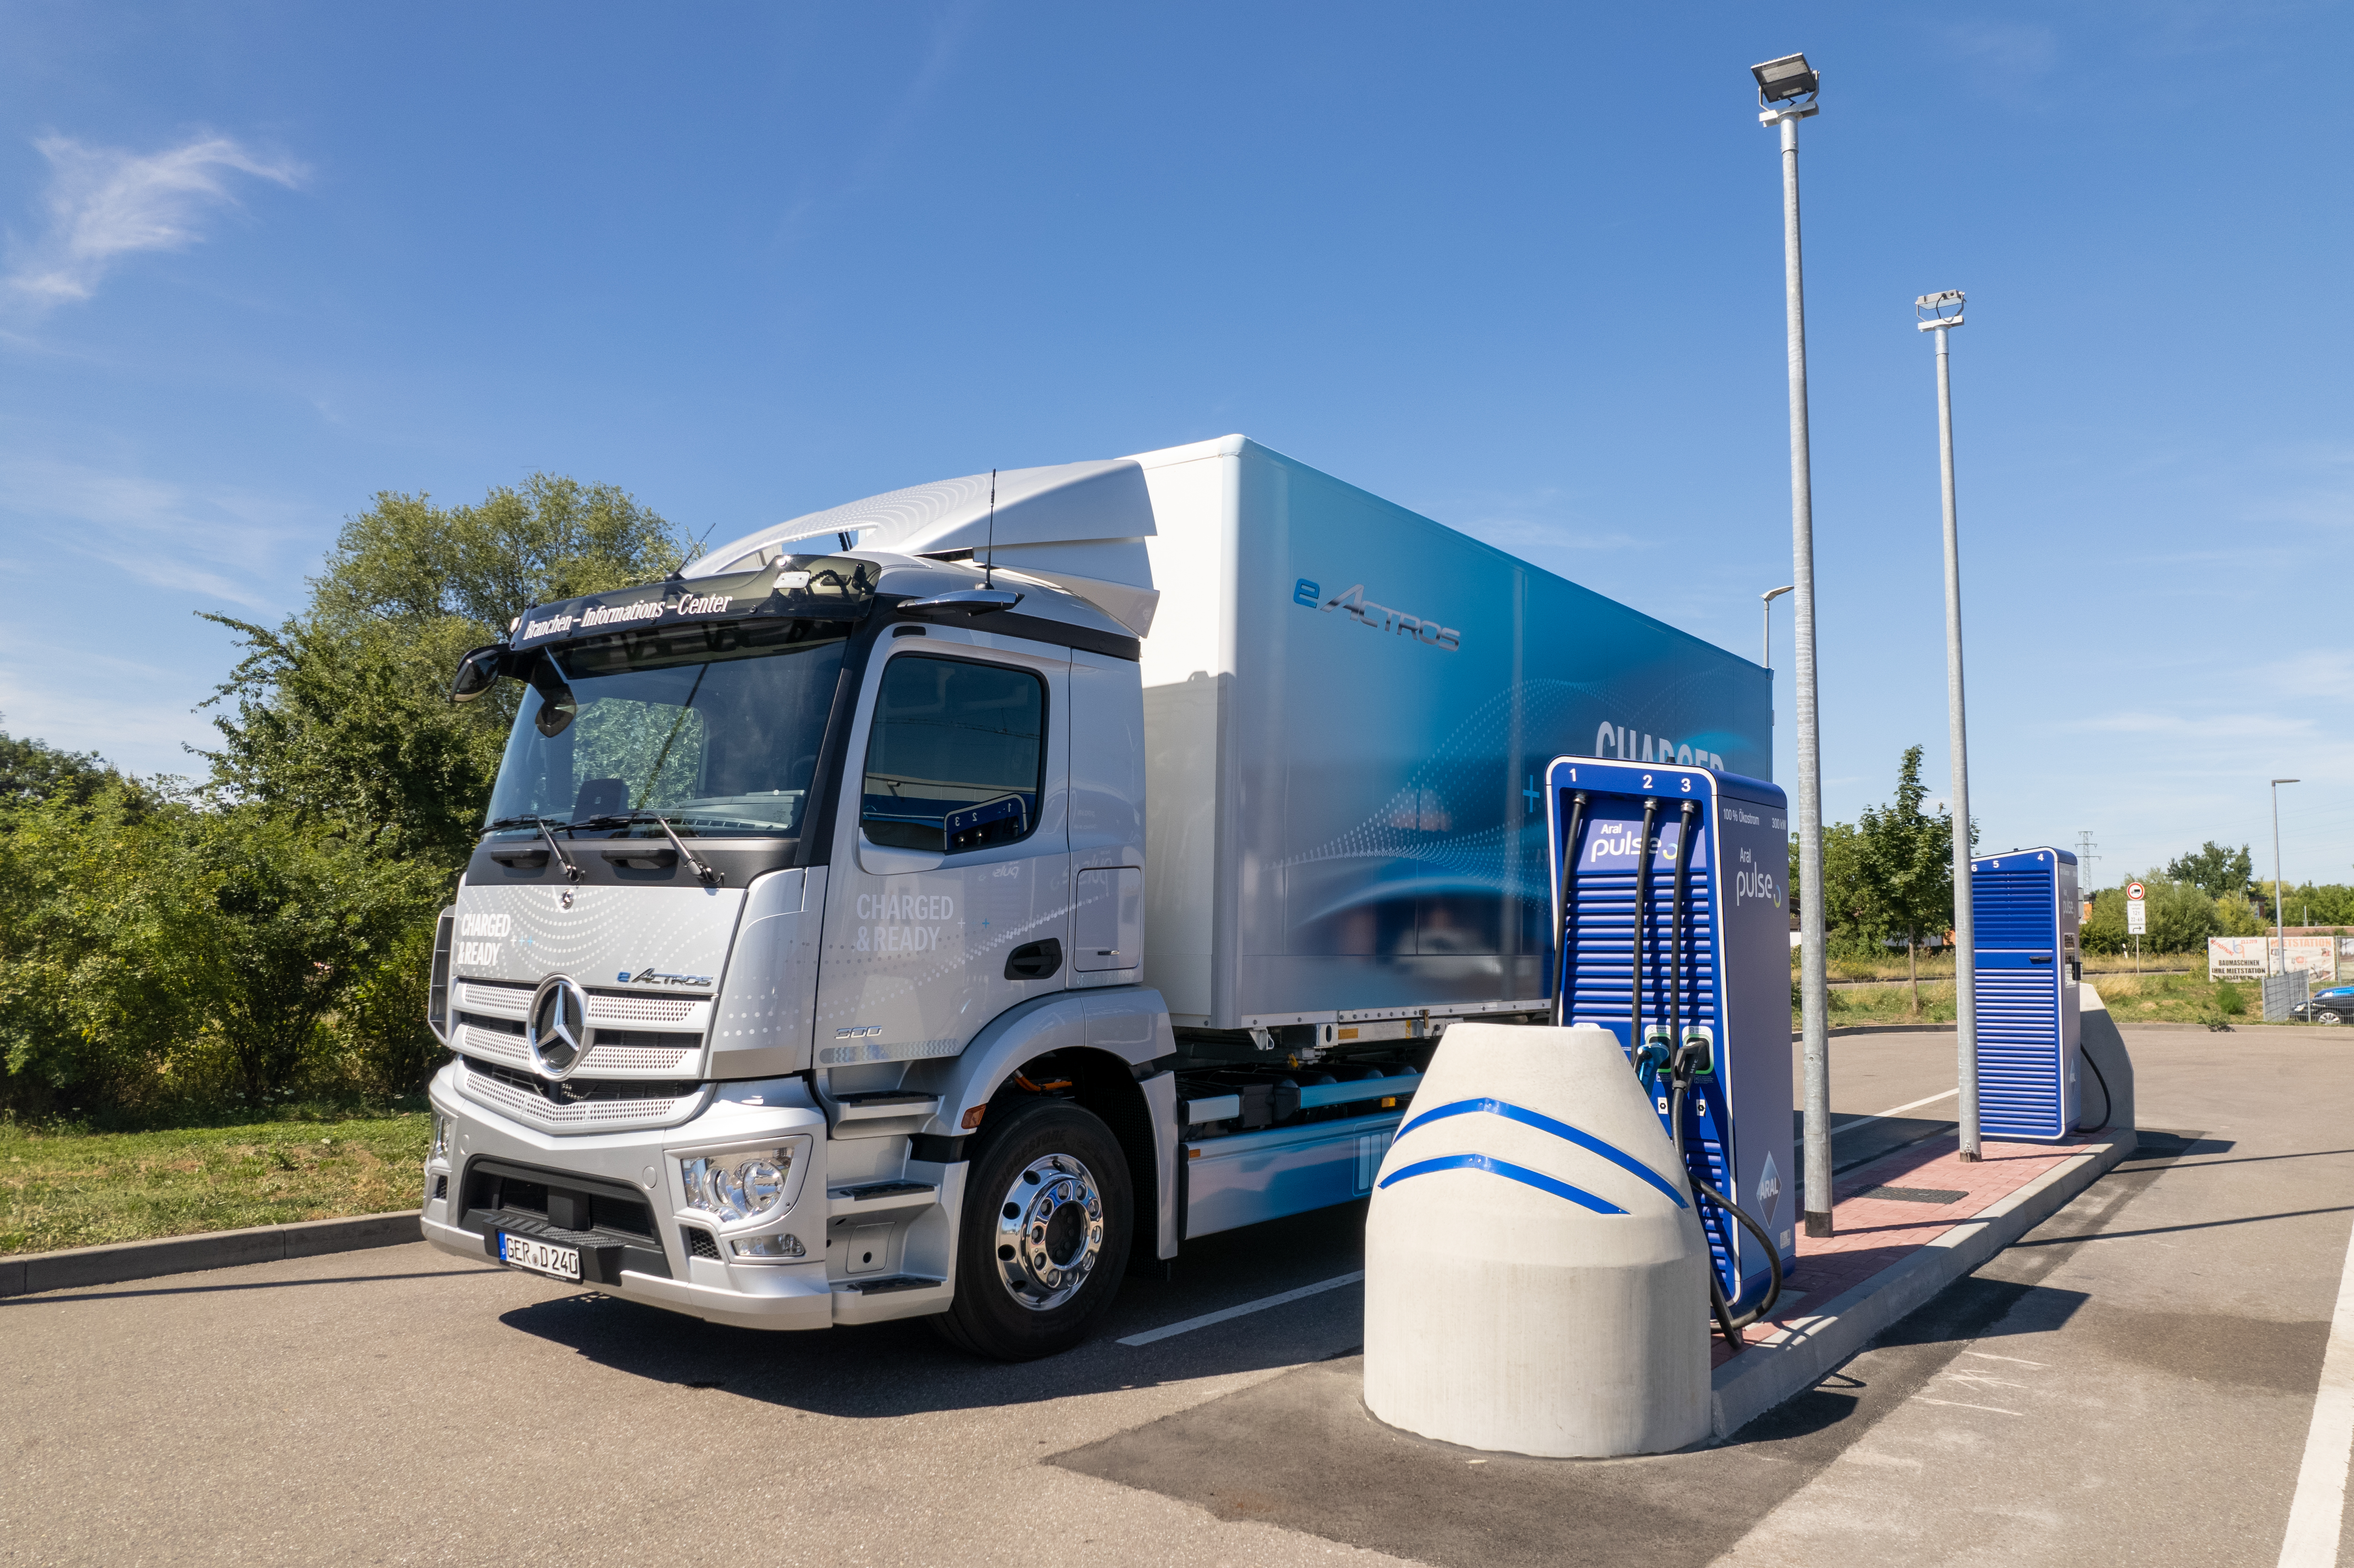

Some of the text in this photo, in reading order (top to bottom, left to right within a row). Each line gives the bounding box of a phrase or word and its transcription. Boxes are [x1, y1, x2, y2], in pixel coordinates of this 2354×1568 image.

[1569, 768, 1691, 792] 1 2 3
[1723, 808, 1760, 826] 100 % Ökostrom
[1772, 817, 1787, 830] 300 kW
[1600, 823, 1622, 835] Aral
[1591, 831, 1662, 863] pulse
[1740, 847, 1751, 863] Aral
[1993, 860, 1999, 868] 5
[2037, 853, 2044, 861] 4
[1736, 861, 1773, 907] pulse
[856, 893, 954, 920] CHARGED
[461, 913, 511, 937] CHARGED
[2270, 938, 2331, 948] METSTATION
[834, 1025, 883, 1039] 300
[1759, 1177, 1779, 1201] ARAL
[507, 1237, 578, 1275] GER D 240
